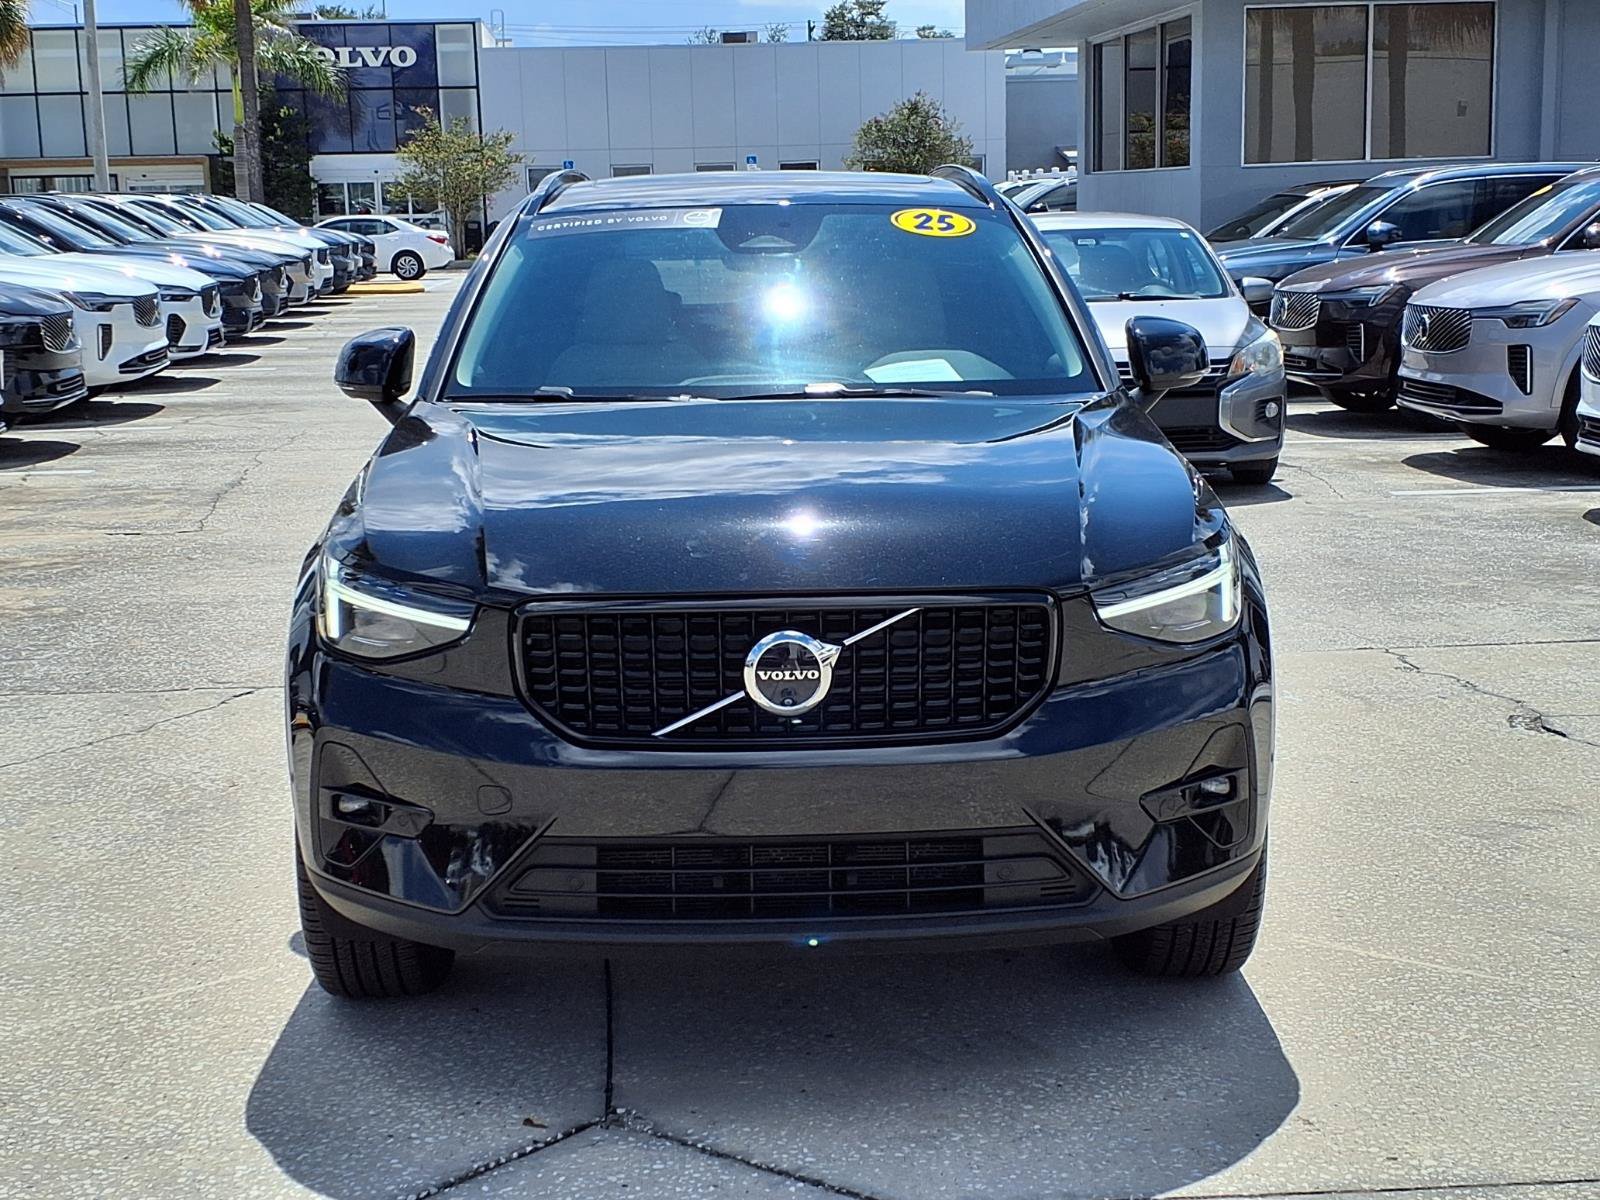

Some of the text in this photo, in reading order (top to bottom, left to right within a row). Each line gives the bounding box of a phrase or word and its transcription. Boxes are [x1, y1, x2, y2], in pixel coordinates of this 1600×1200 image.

[306, 46, 417, 68] OLVO
[537, 219, 602, 231] CERTIFIED
[627, 215, 668, 223] VOLVO
[913, 212, 955, 232] 25
[756, 669, 820, 681] VOLVO
